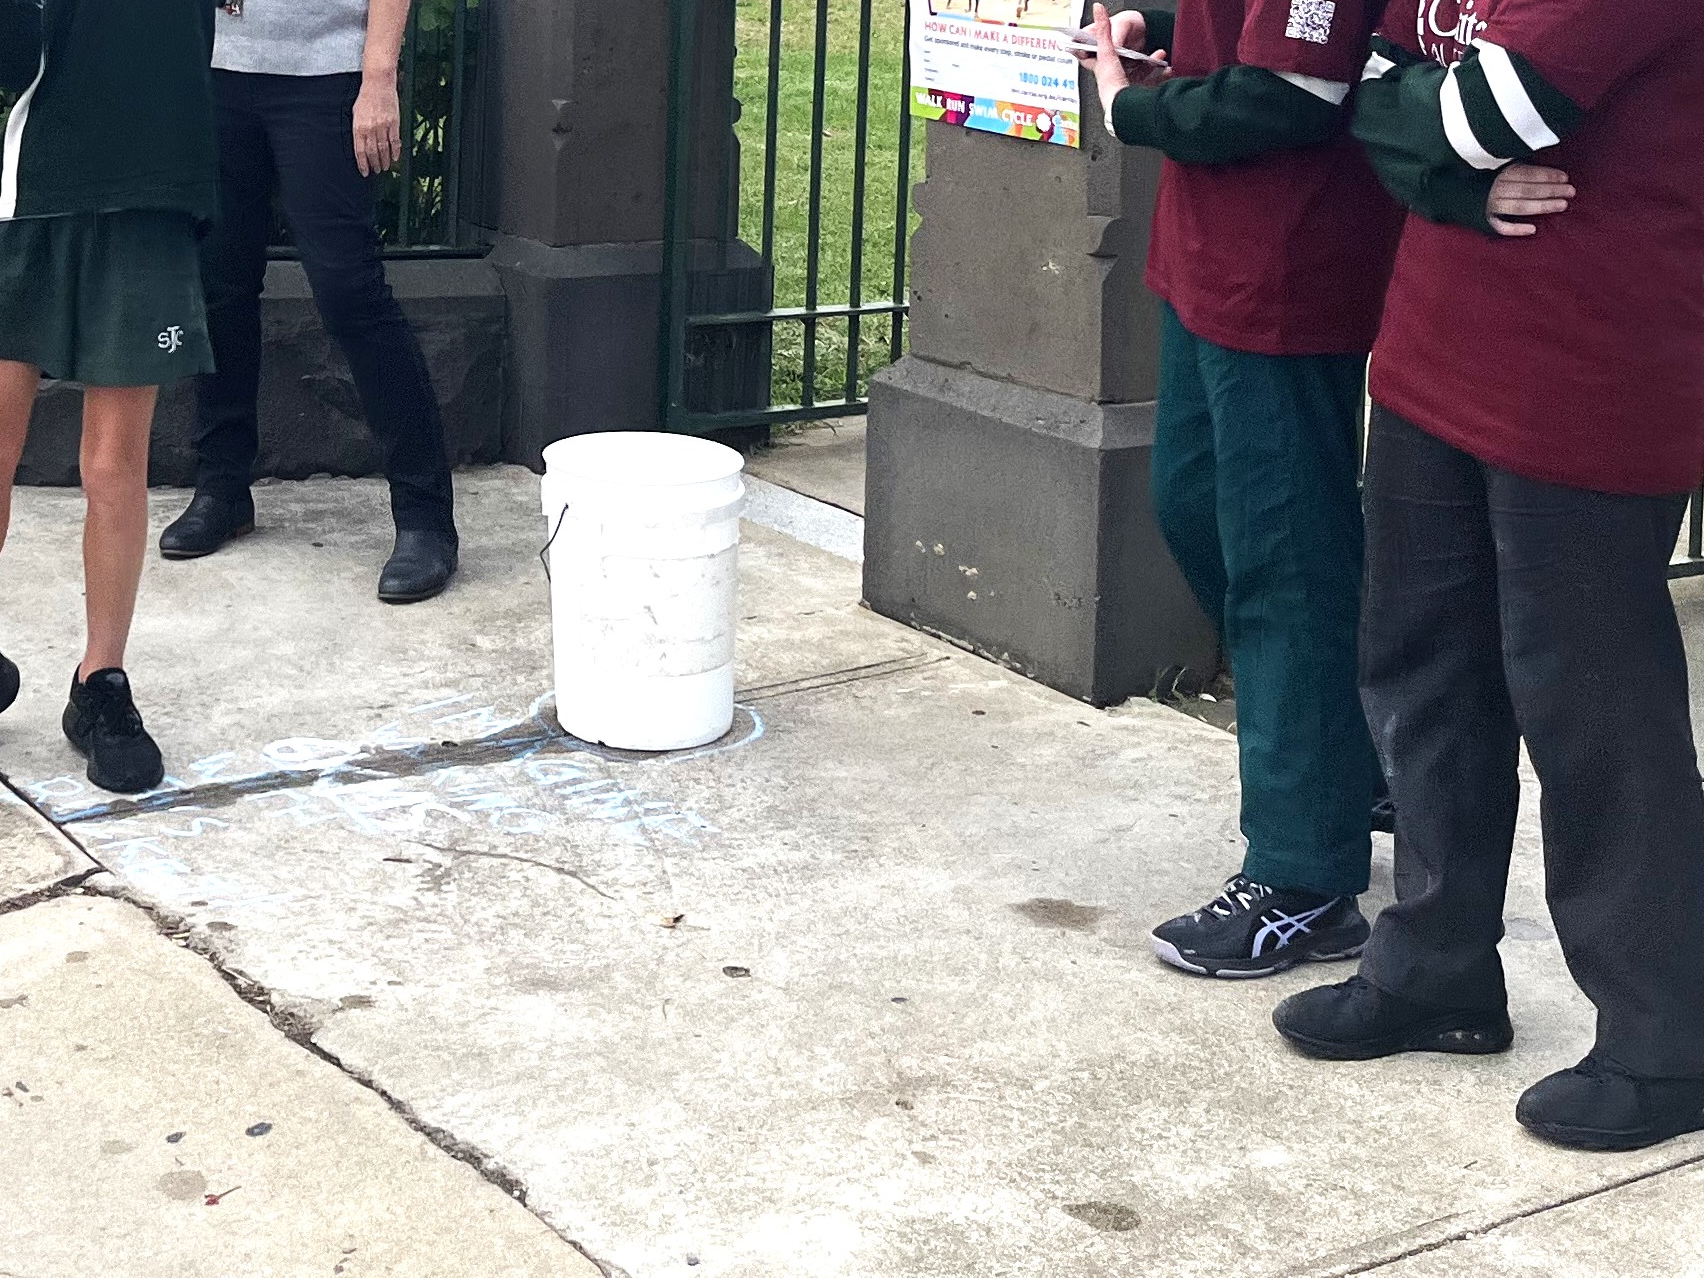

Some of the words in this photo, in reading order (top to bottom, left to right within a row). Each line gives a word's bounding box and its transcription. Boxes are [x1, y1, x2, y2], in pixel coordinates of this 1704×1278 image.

[924, 21, 947, 33] HOW
[949, 24, 967, 36] CAN
[974, 30, 1000, 42] MAKE
[1002, 34, 1009, 43] A
[1019, 72, 1039, 85] 1800
[1041, 75, 1060, 88] 024
[915, 91, 944, 109] WALK
[945, 97, 966, 114] RUN
[968, 103, 999, 120] SWIM
[1001, 109, 1034, 127] CYCLE
